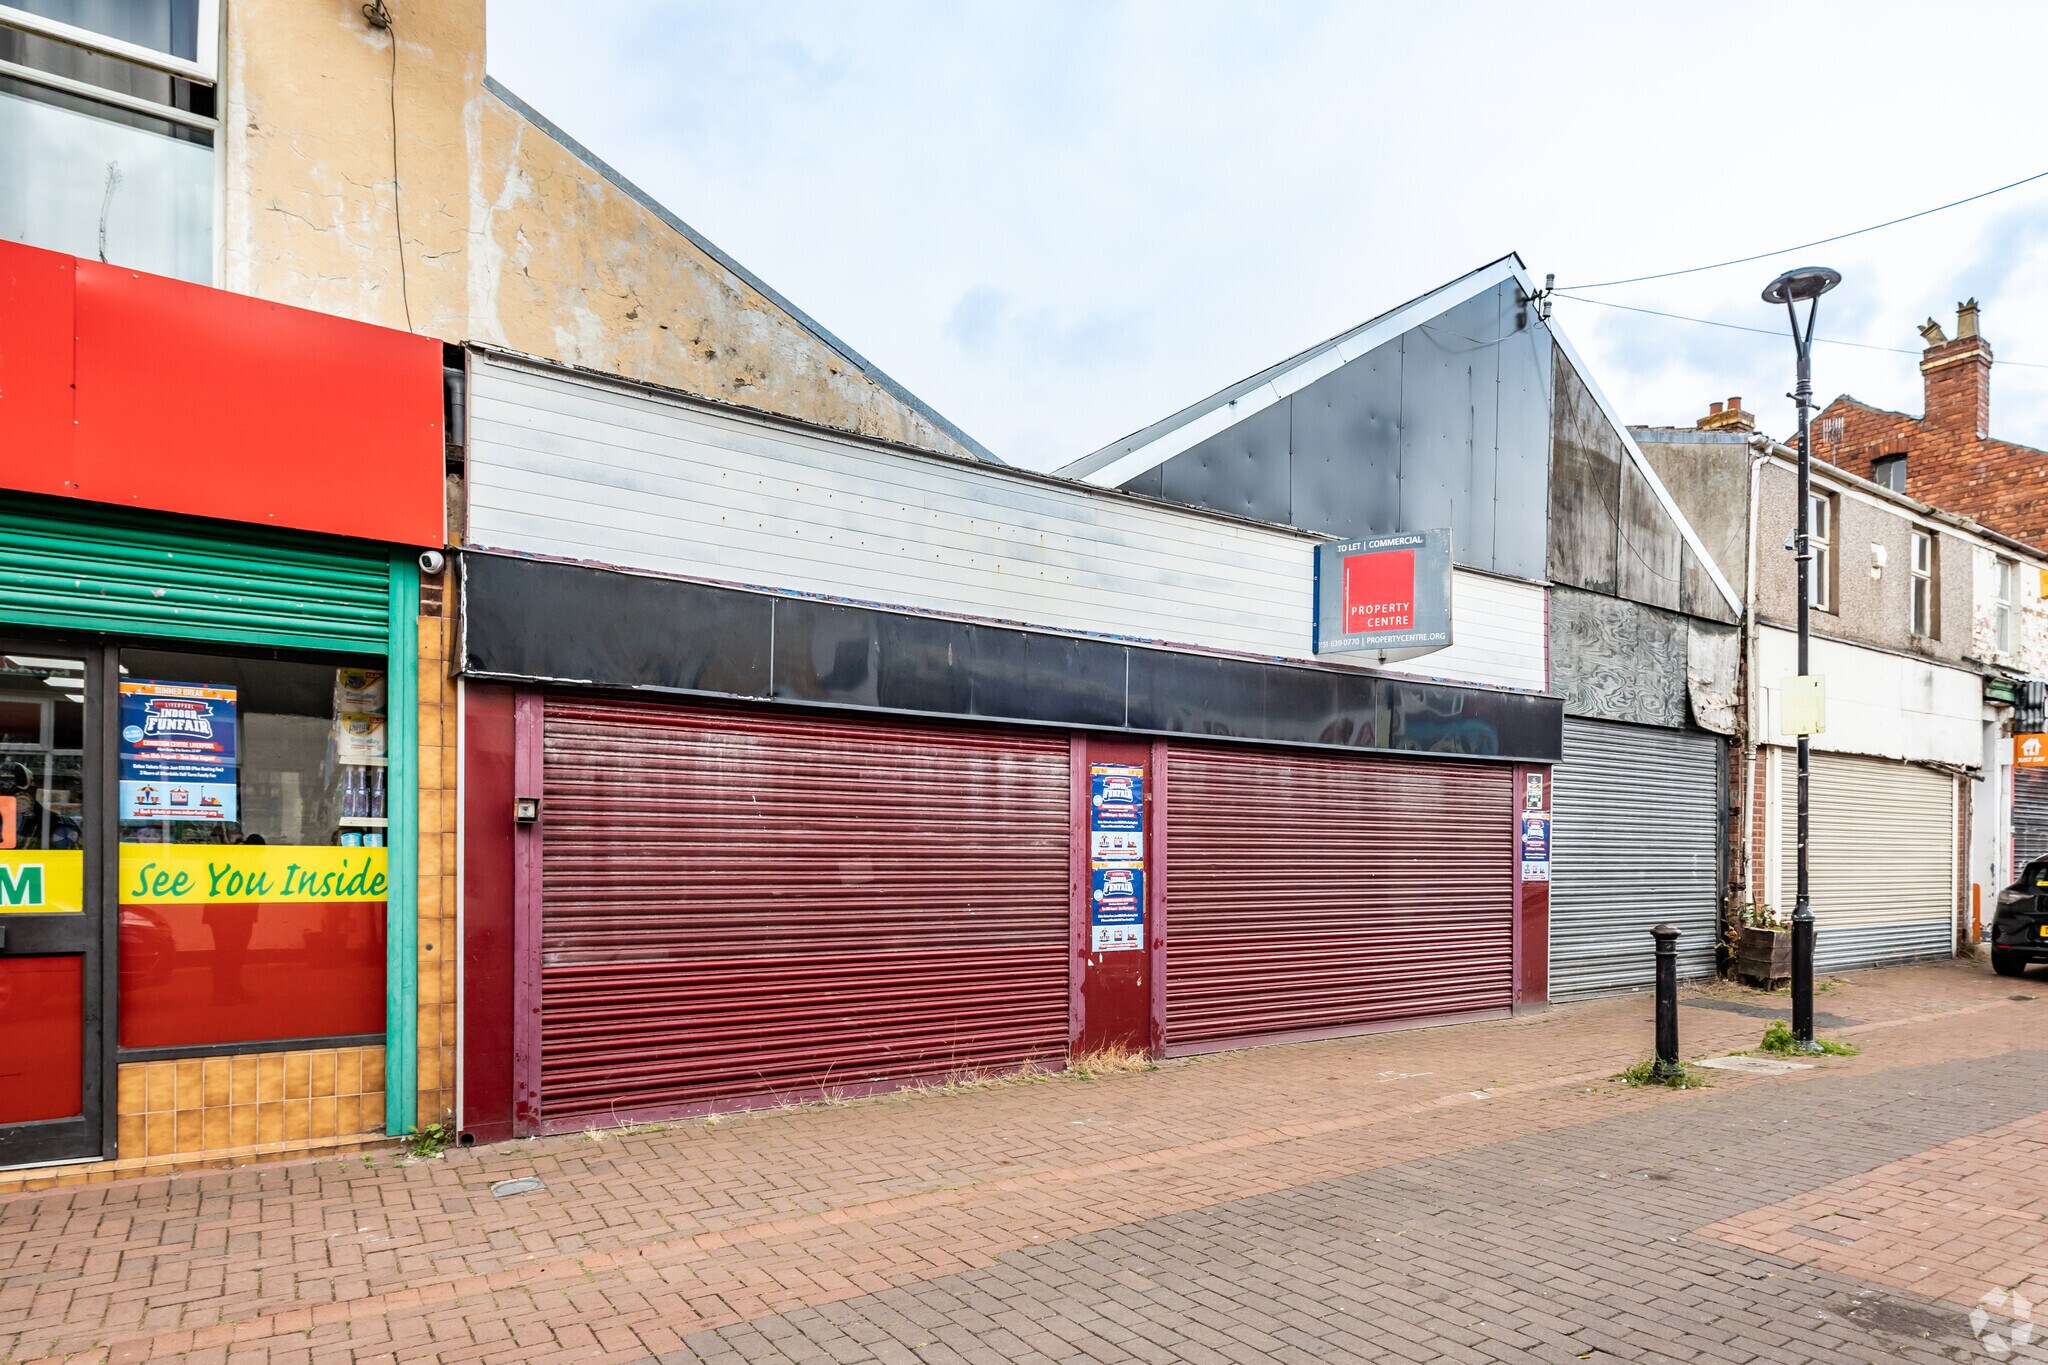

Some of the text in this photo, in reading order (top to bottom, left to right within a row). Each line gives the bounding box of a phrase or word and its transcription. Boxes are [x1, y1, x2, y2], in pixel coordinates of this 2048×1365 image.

[1338, 535, 1424, 552] TO LET COMMERCIAL
[1351, 602, 1410, 616] PROPERTY
[1367, 616, 1409, 628] CENTRE
[1330, 639, 1342, 647] 639
[1343, 637, 1360, 646] 0770
[1366, 632, 1446, 644] PROPERTYCENTRE.ORG
[154, 686, 204, 696] SUMMER BREAK
[160, 708, 198, 719] INDOOR
[148, 718, 209, 734] FUNFAIR
[132, 856, 388, 898] See You Inside
